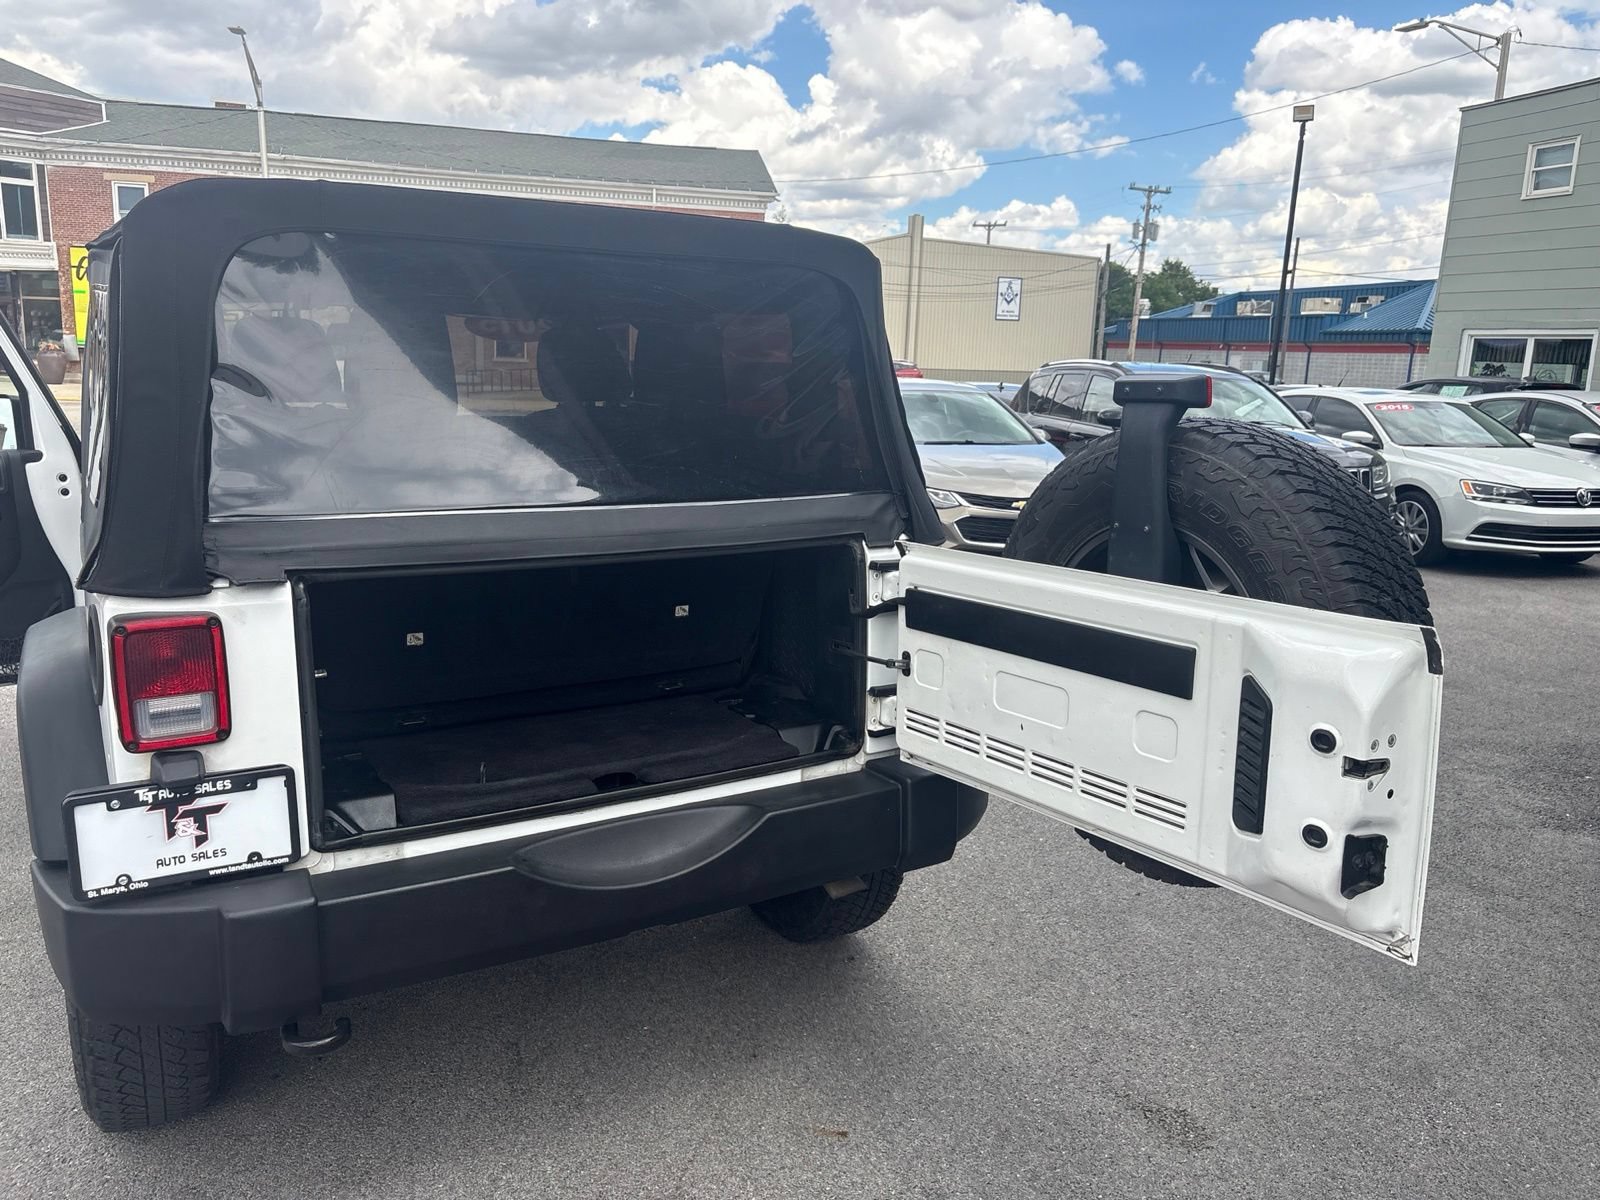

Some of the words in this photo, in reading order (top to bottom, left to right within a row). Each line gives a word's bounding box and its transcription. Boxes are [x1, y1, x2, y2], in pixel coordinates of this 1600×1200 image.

[194, 779, 232, 795] SALES
[156, 854, 186, 869] AUTO
[191, 847, 227, 863] SALES
[87, 890, 99, 899] St.
[129, 880, 149, 890] Ohio
